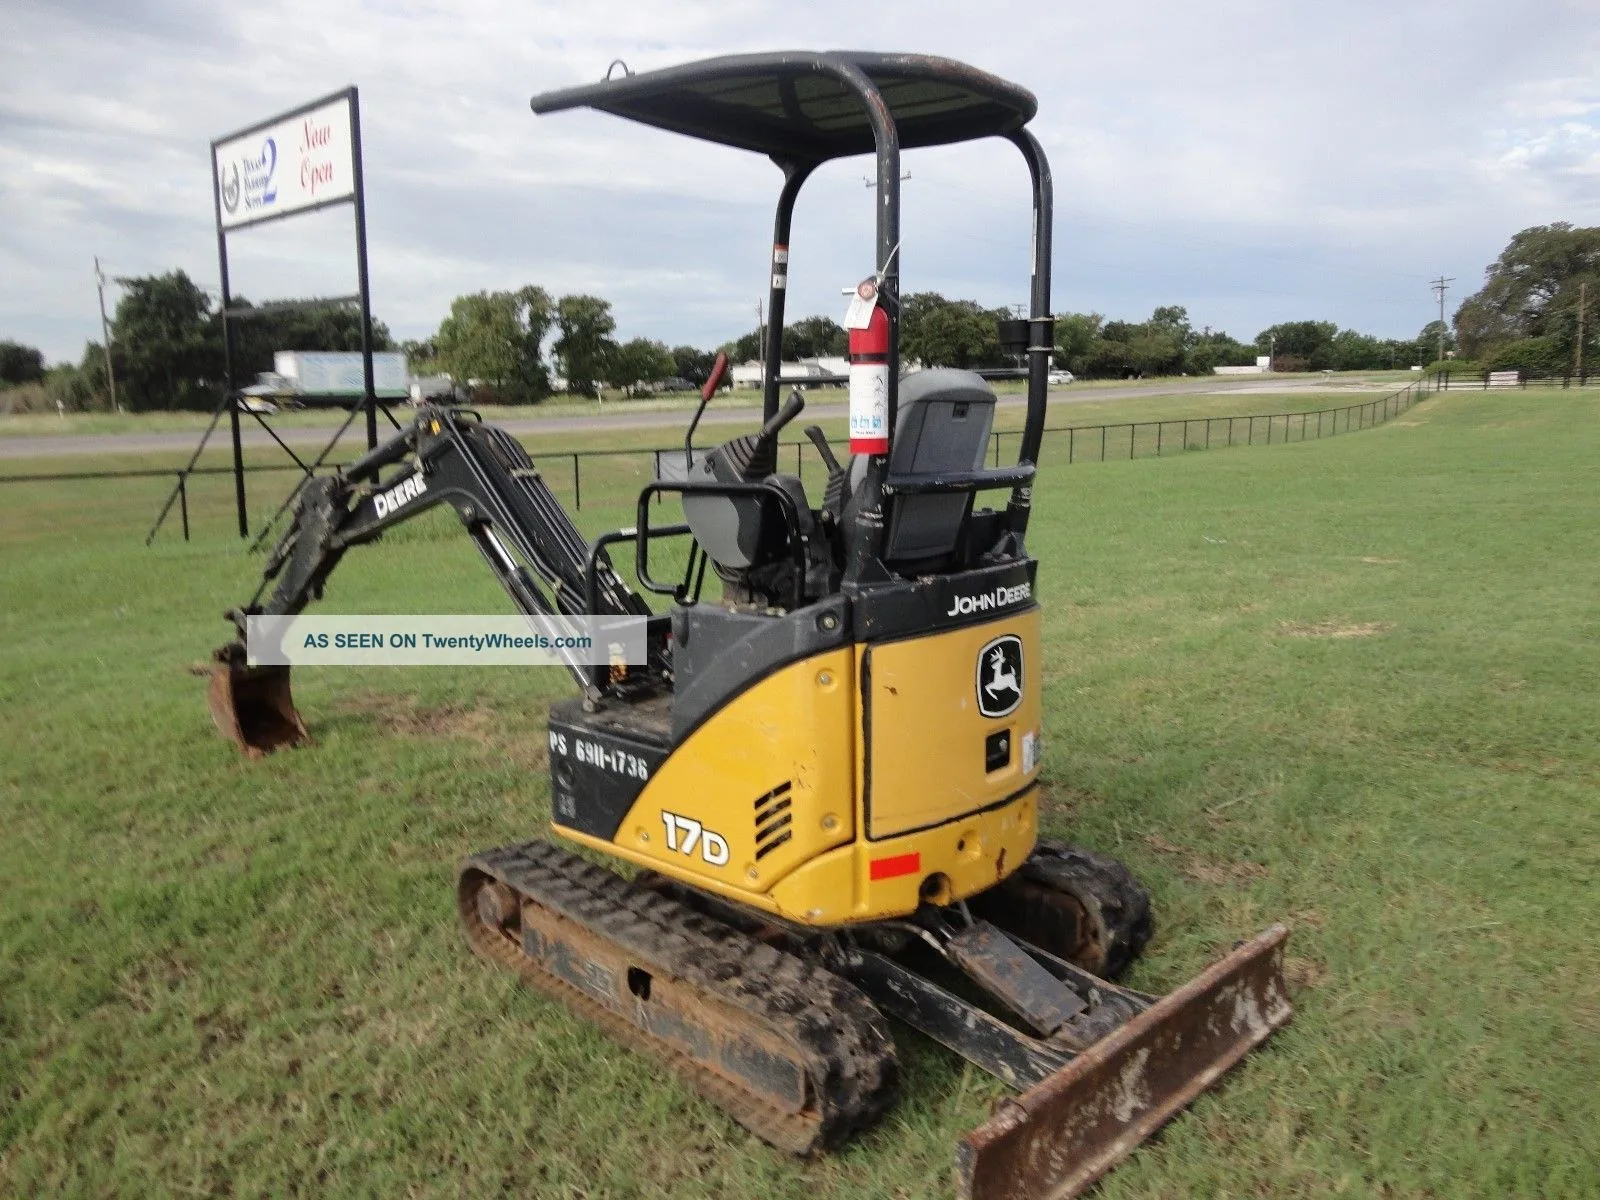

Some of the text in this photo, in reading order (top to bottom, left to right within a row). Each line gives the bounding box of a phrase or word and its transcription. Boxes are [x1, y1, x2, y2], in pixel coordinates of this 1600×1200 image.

[301, 157, 333, 196] Open
[373, 471, 427, 519] DEERE
[947, 592, 995, 616] JOHN
[661, 808, 730, 867] 17D
